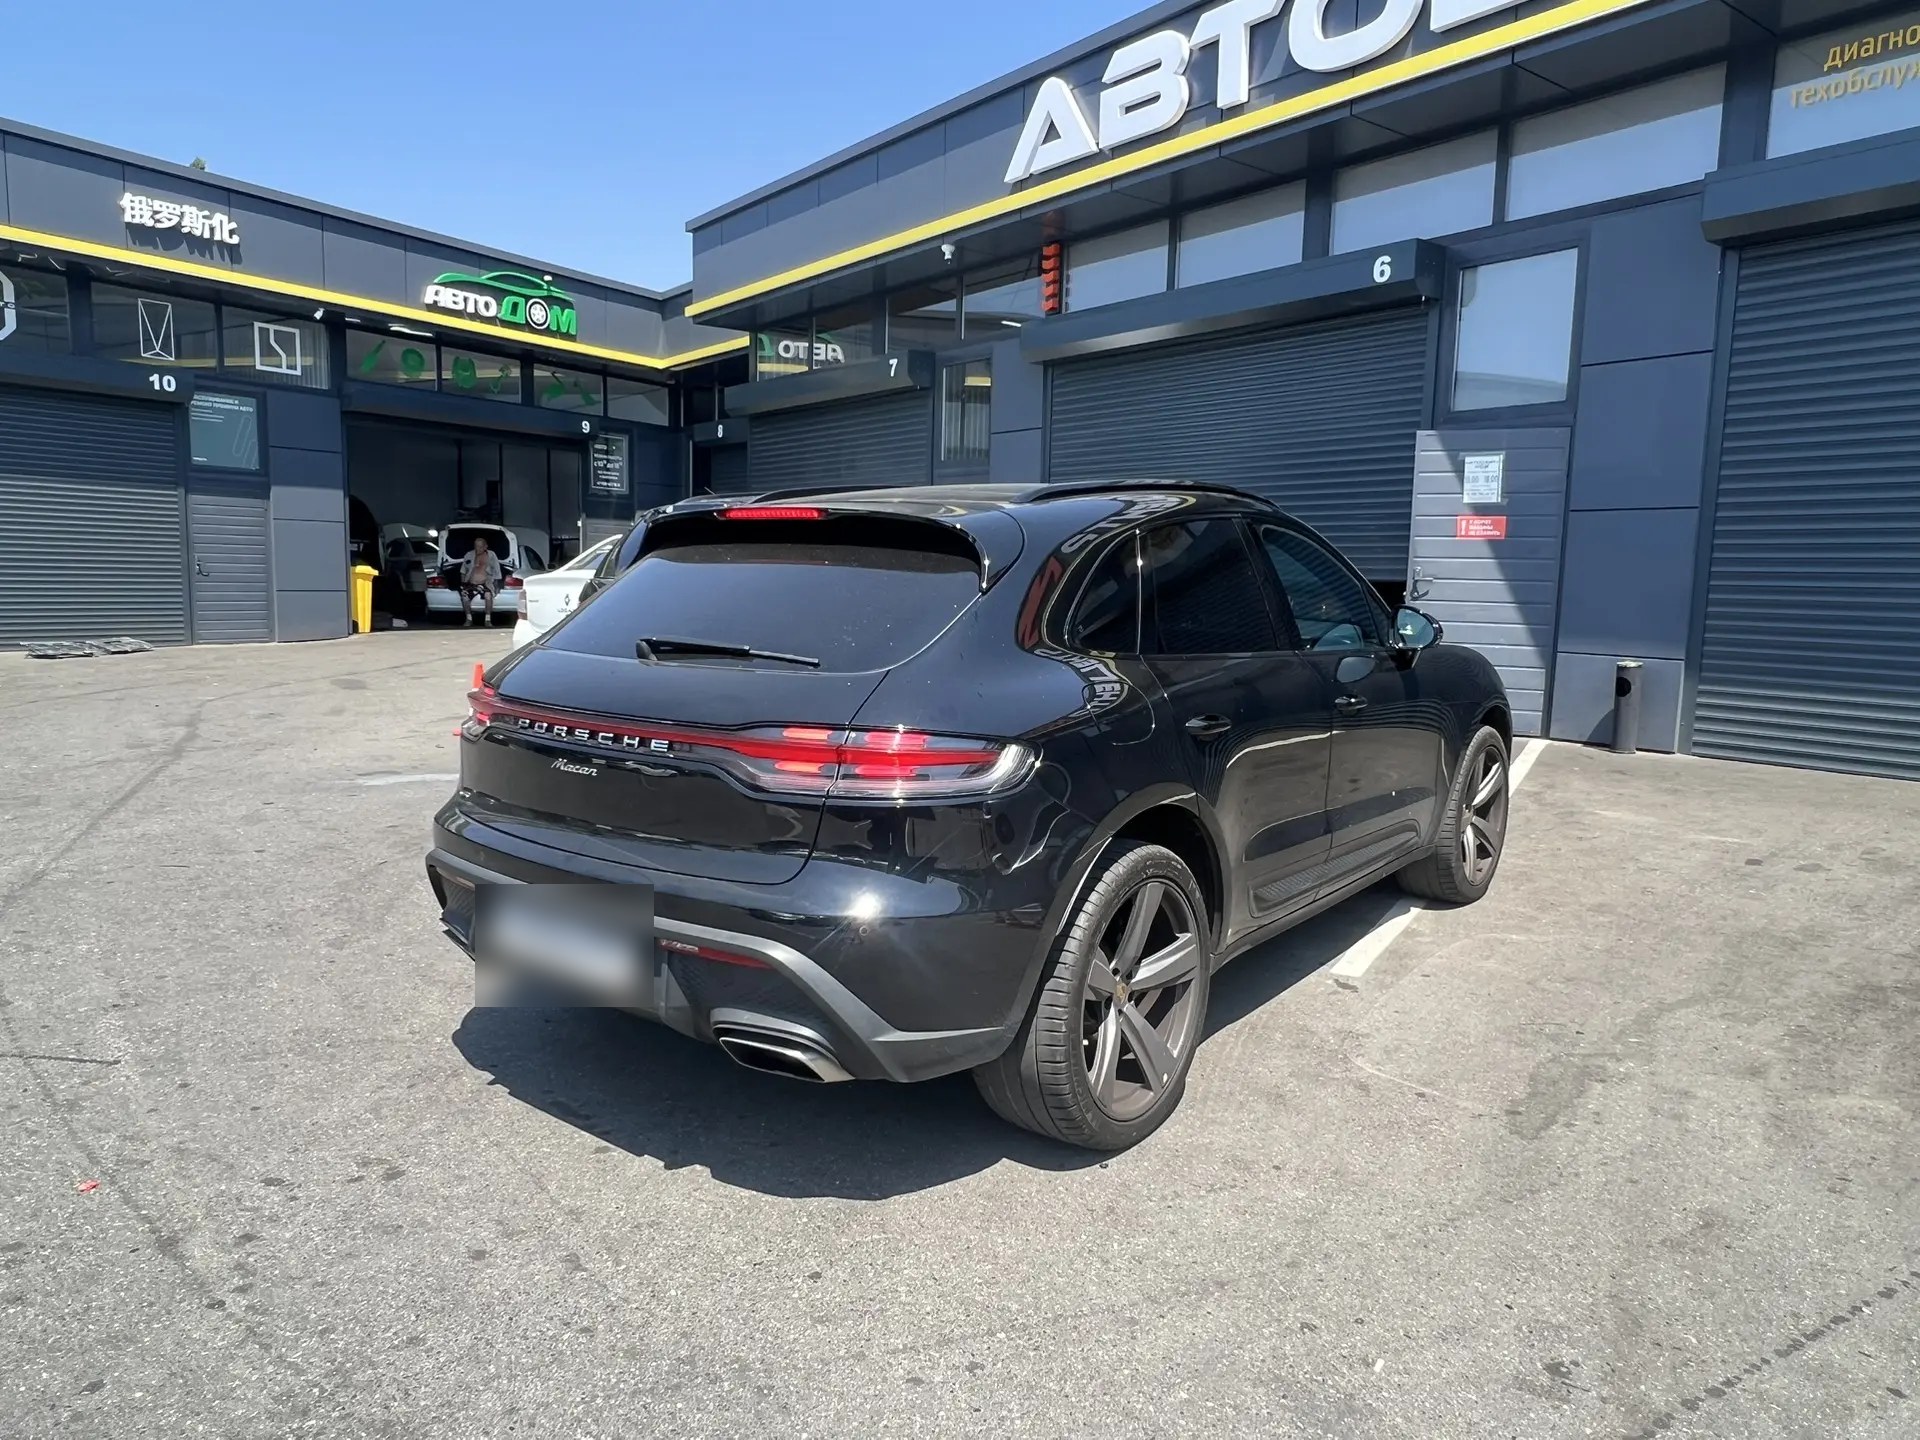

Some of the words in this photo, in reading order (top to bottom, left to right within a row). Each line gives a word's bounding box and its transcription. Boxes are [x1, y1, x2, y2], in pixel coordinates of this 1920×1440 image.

[1004, 0, 1530, 184] АВТО
[119, 192, 240, 244] 俄罗斯化
[1373, 255, 1391, 283] 6
[889, 358, 898, 377] 7
[149, 373, 176, 392] 10
[582, 420, 590, 433] 9
[717, 424, 723, 438] 8
[518, 718, 669, 752] PORSCHE
[551, 757, 598, 776] Macan
